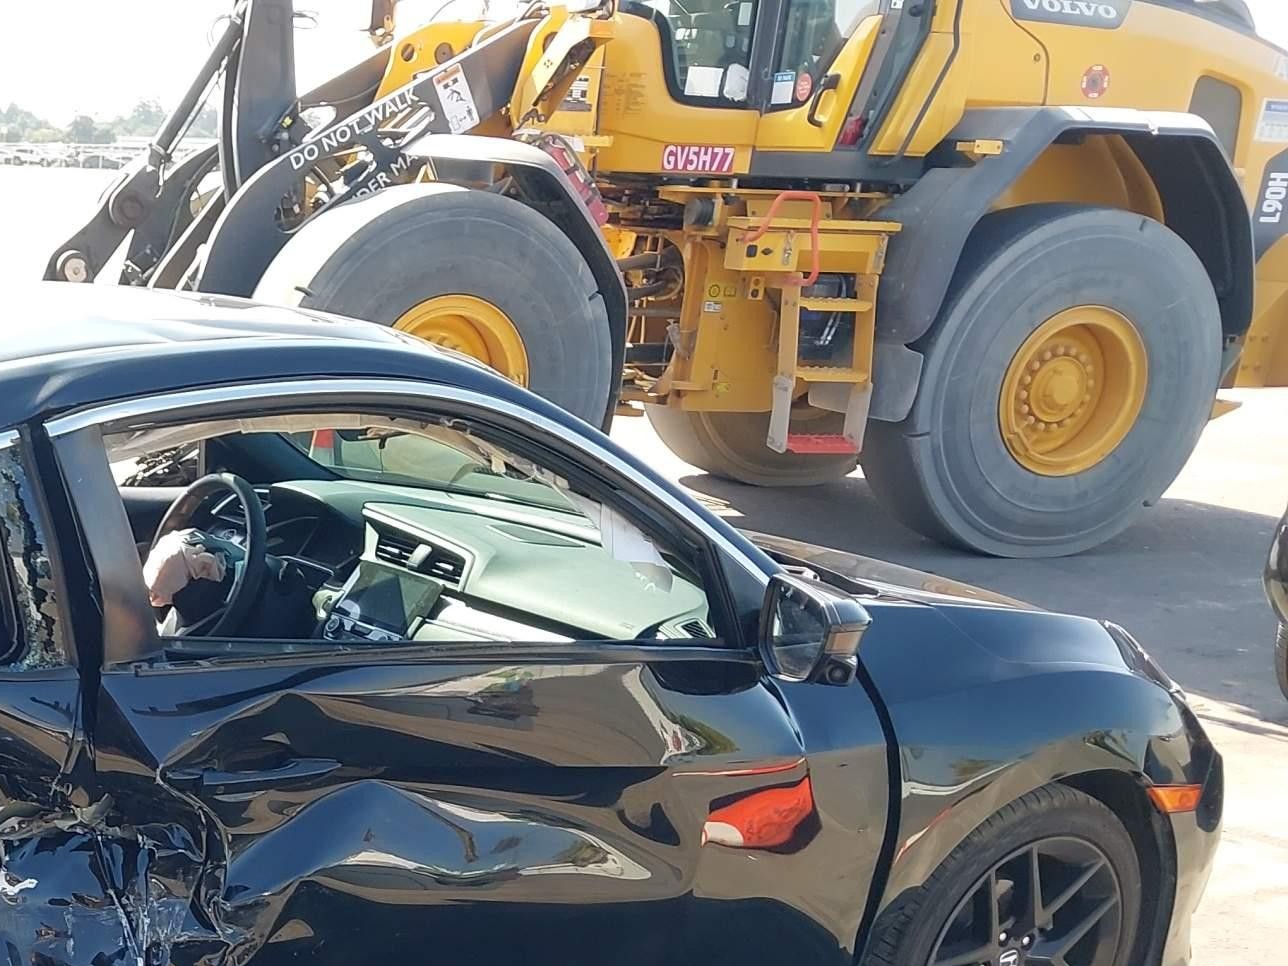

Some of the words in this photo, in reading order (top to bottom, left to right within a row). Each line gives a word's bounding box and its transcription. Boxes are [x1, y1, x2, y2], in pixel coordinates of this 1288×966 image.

[1022, 0, 1117, 19] VOLVO
[289, 143, 319, 170] DO
[321, 117, 362, 152] NOT
[363, 86, 420, 129] WALK
[663, 144, 735, 172] GV5H77
[351, 171, 392, 199] DER
[1259, 172, 1288, 223] L90H
